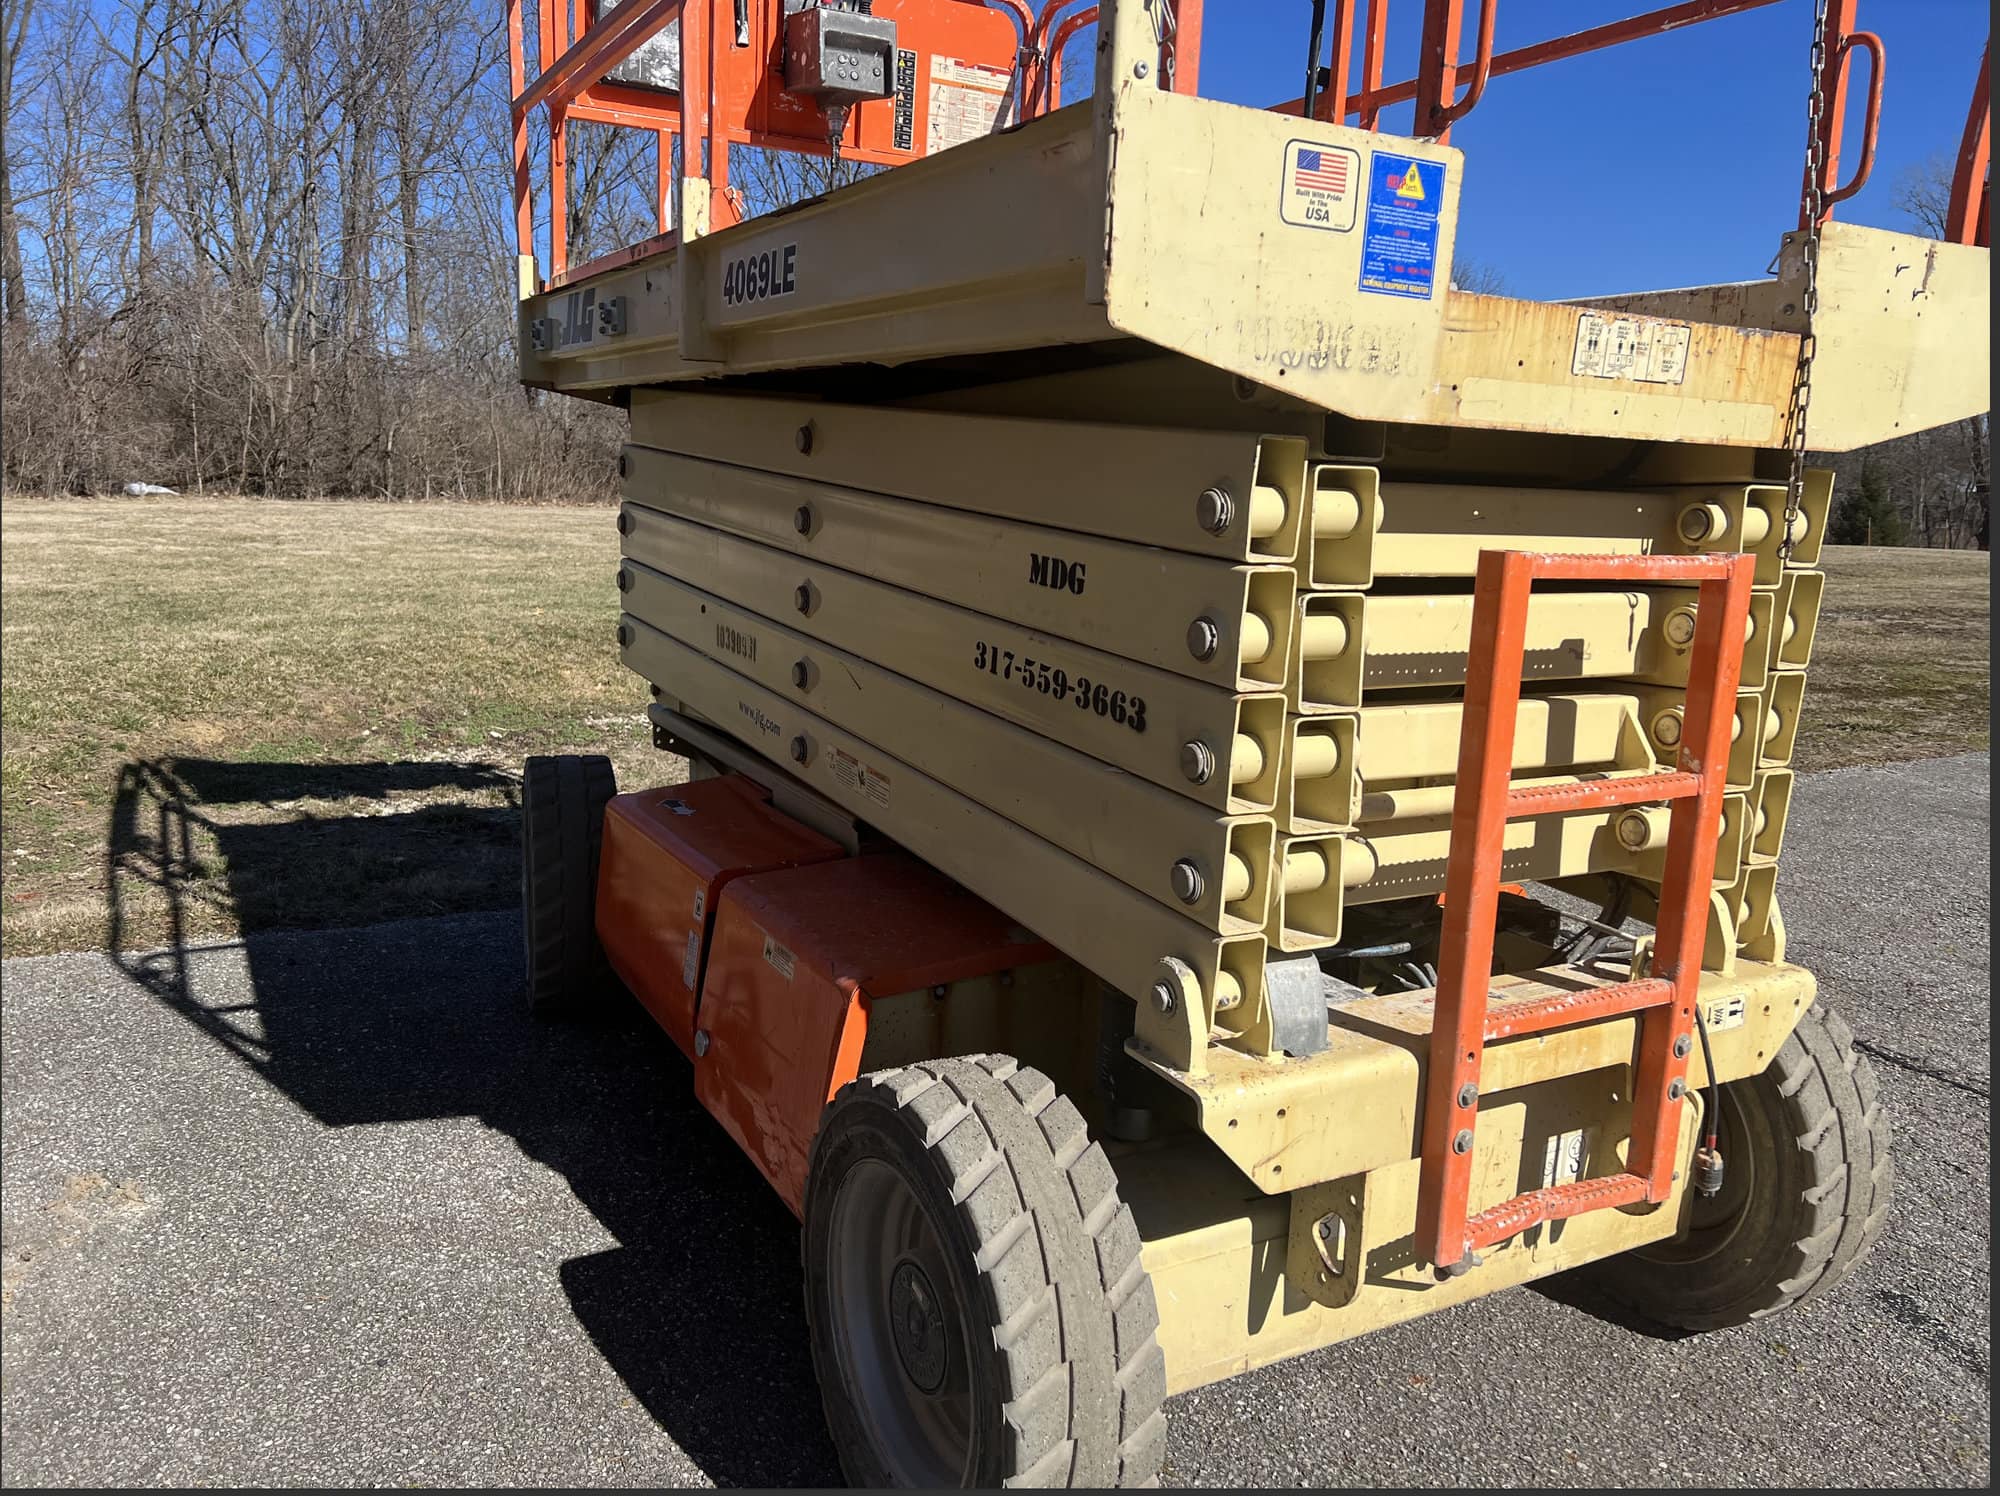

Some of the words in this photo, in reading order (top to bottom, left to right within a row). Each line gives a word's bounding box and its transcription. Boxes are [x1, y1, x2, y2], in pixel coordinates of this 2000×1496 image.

[1296, 188, 1310, 197] Built
[1312, 190, 1325, 199] With
[1327, 193, 1342, 202] Pride
[1306, 207, 1329, 222] USA
[723, 245, 797, 304] 4069LE
[1029, 553, 1086, 595] MDG
[974, 641, 1147, 732] 317-559-3663
[739, 702, 781, 736] www.jlg.com
